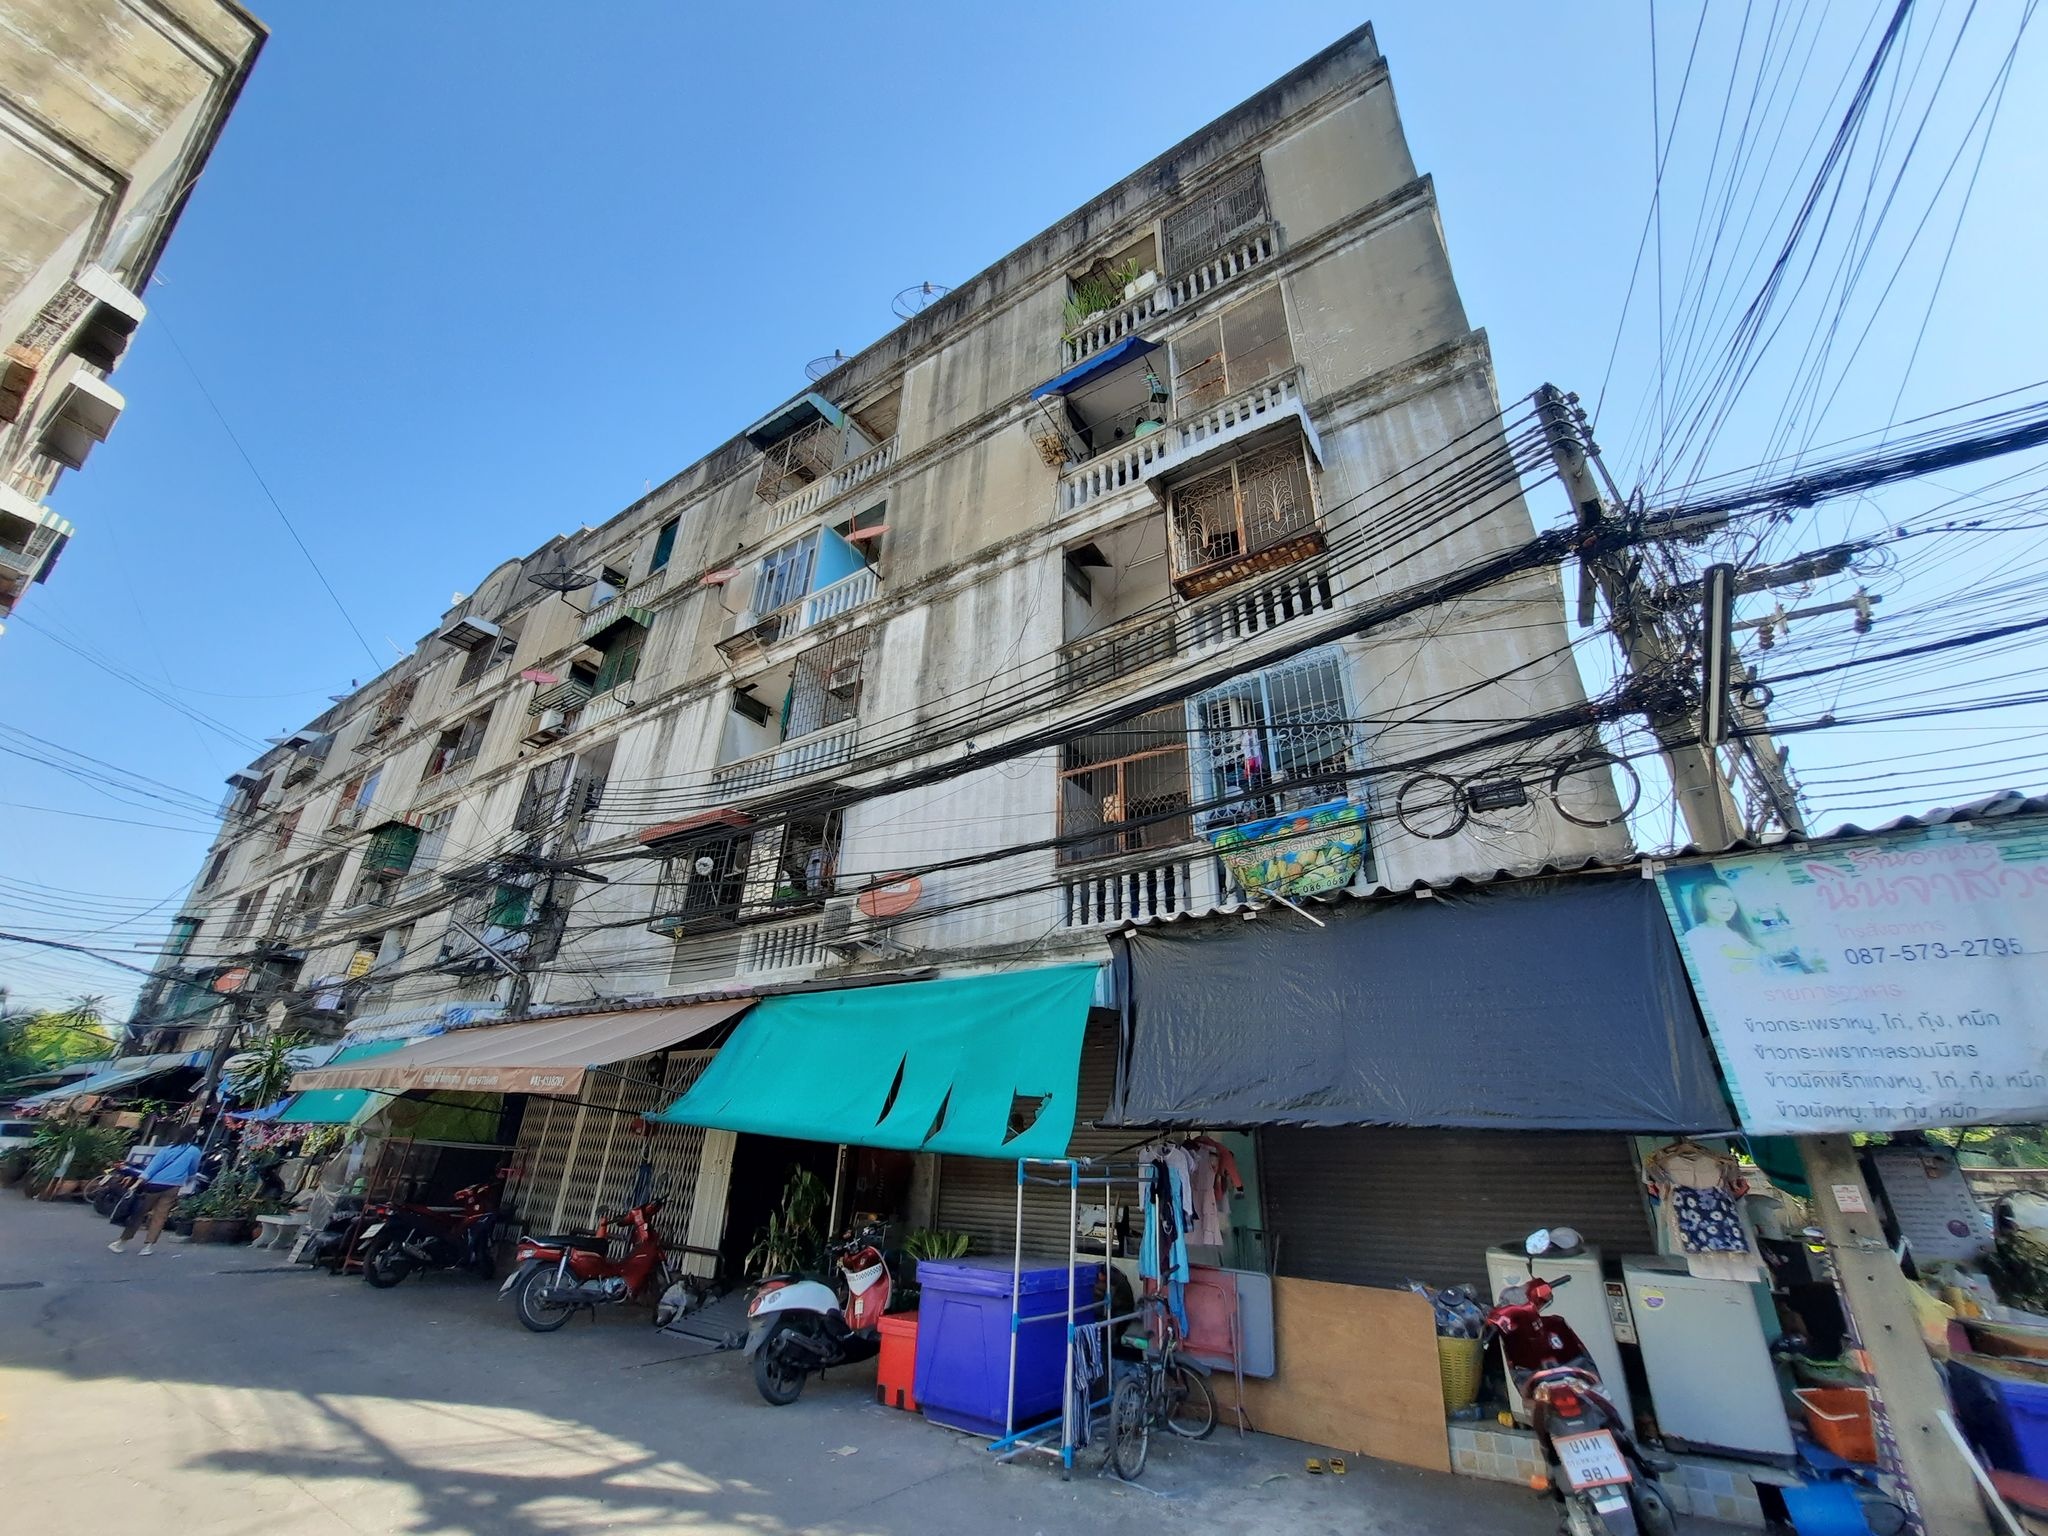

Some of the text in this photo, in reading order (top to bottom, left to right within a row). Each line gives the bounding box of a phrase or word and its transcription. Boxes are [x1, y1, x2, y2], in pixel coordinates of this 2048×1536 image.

[1850, 843, 1995, 873] ร้านอาหาร
[1844, 937, 2024, 966] 087-573-2795
[1581, 1466, 1613, 1482] 981
